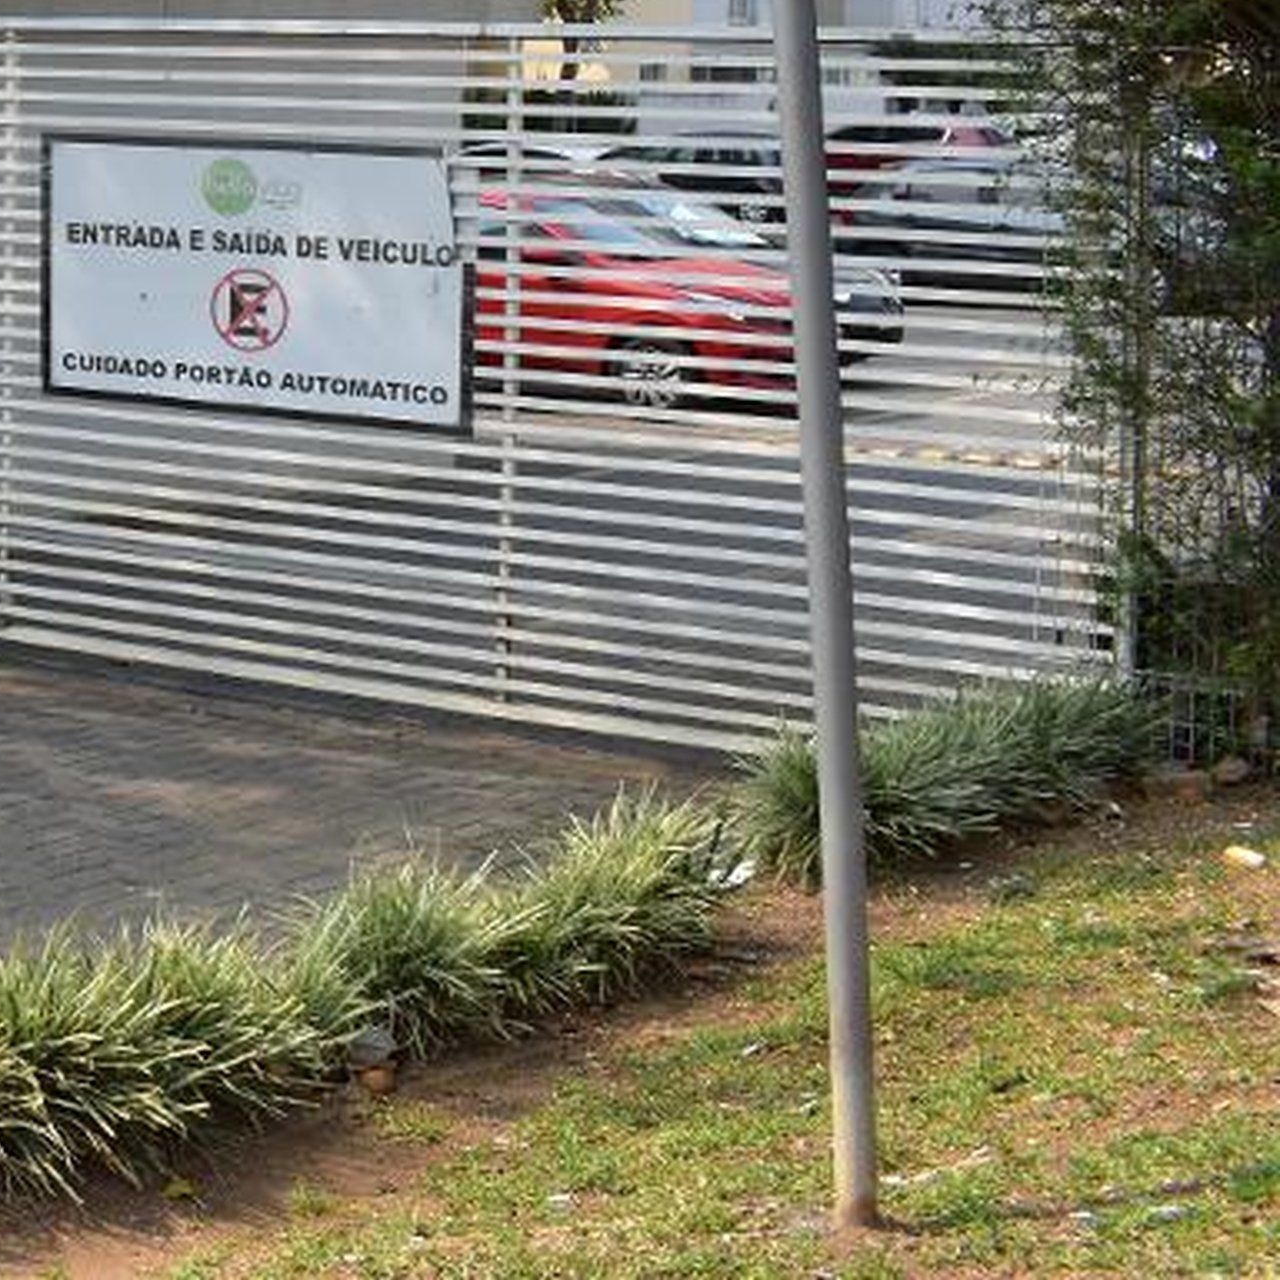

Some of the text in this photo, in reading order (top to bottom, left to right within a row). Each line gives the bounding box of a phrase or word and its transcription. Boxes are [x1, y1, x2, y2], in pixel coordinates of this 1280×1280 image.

[65, 222, 181, 249] ENTRADA
[190, 229, 205, 251] E
[296, 235, 329, 260] DE
[61, 352, 167, 378] CUIDADO
